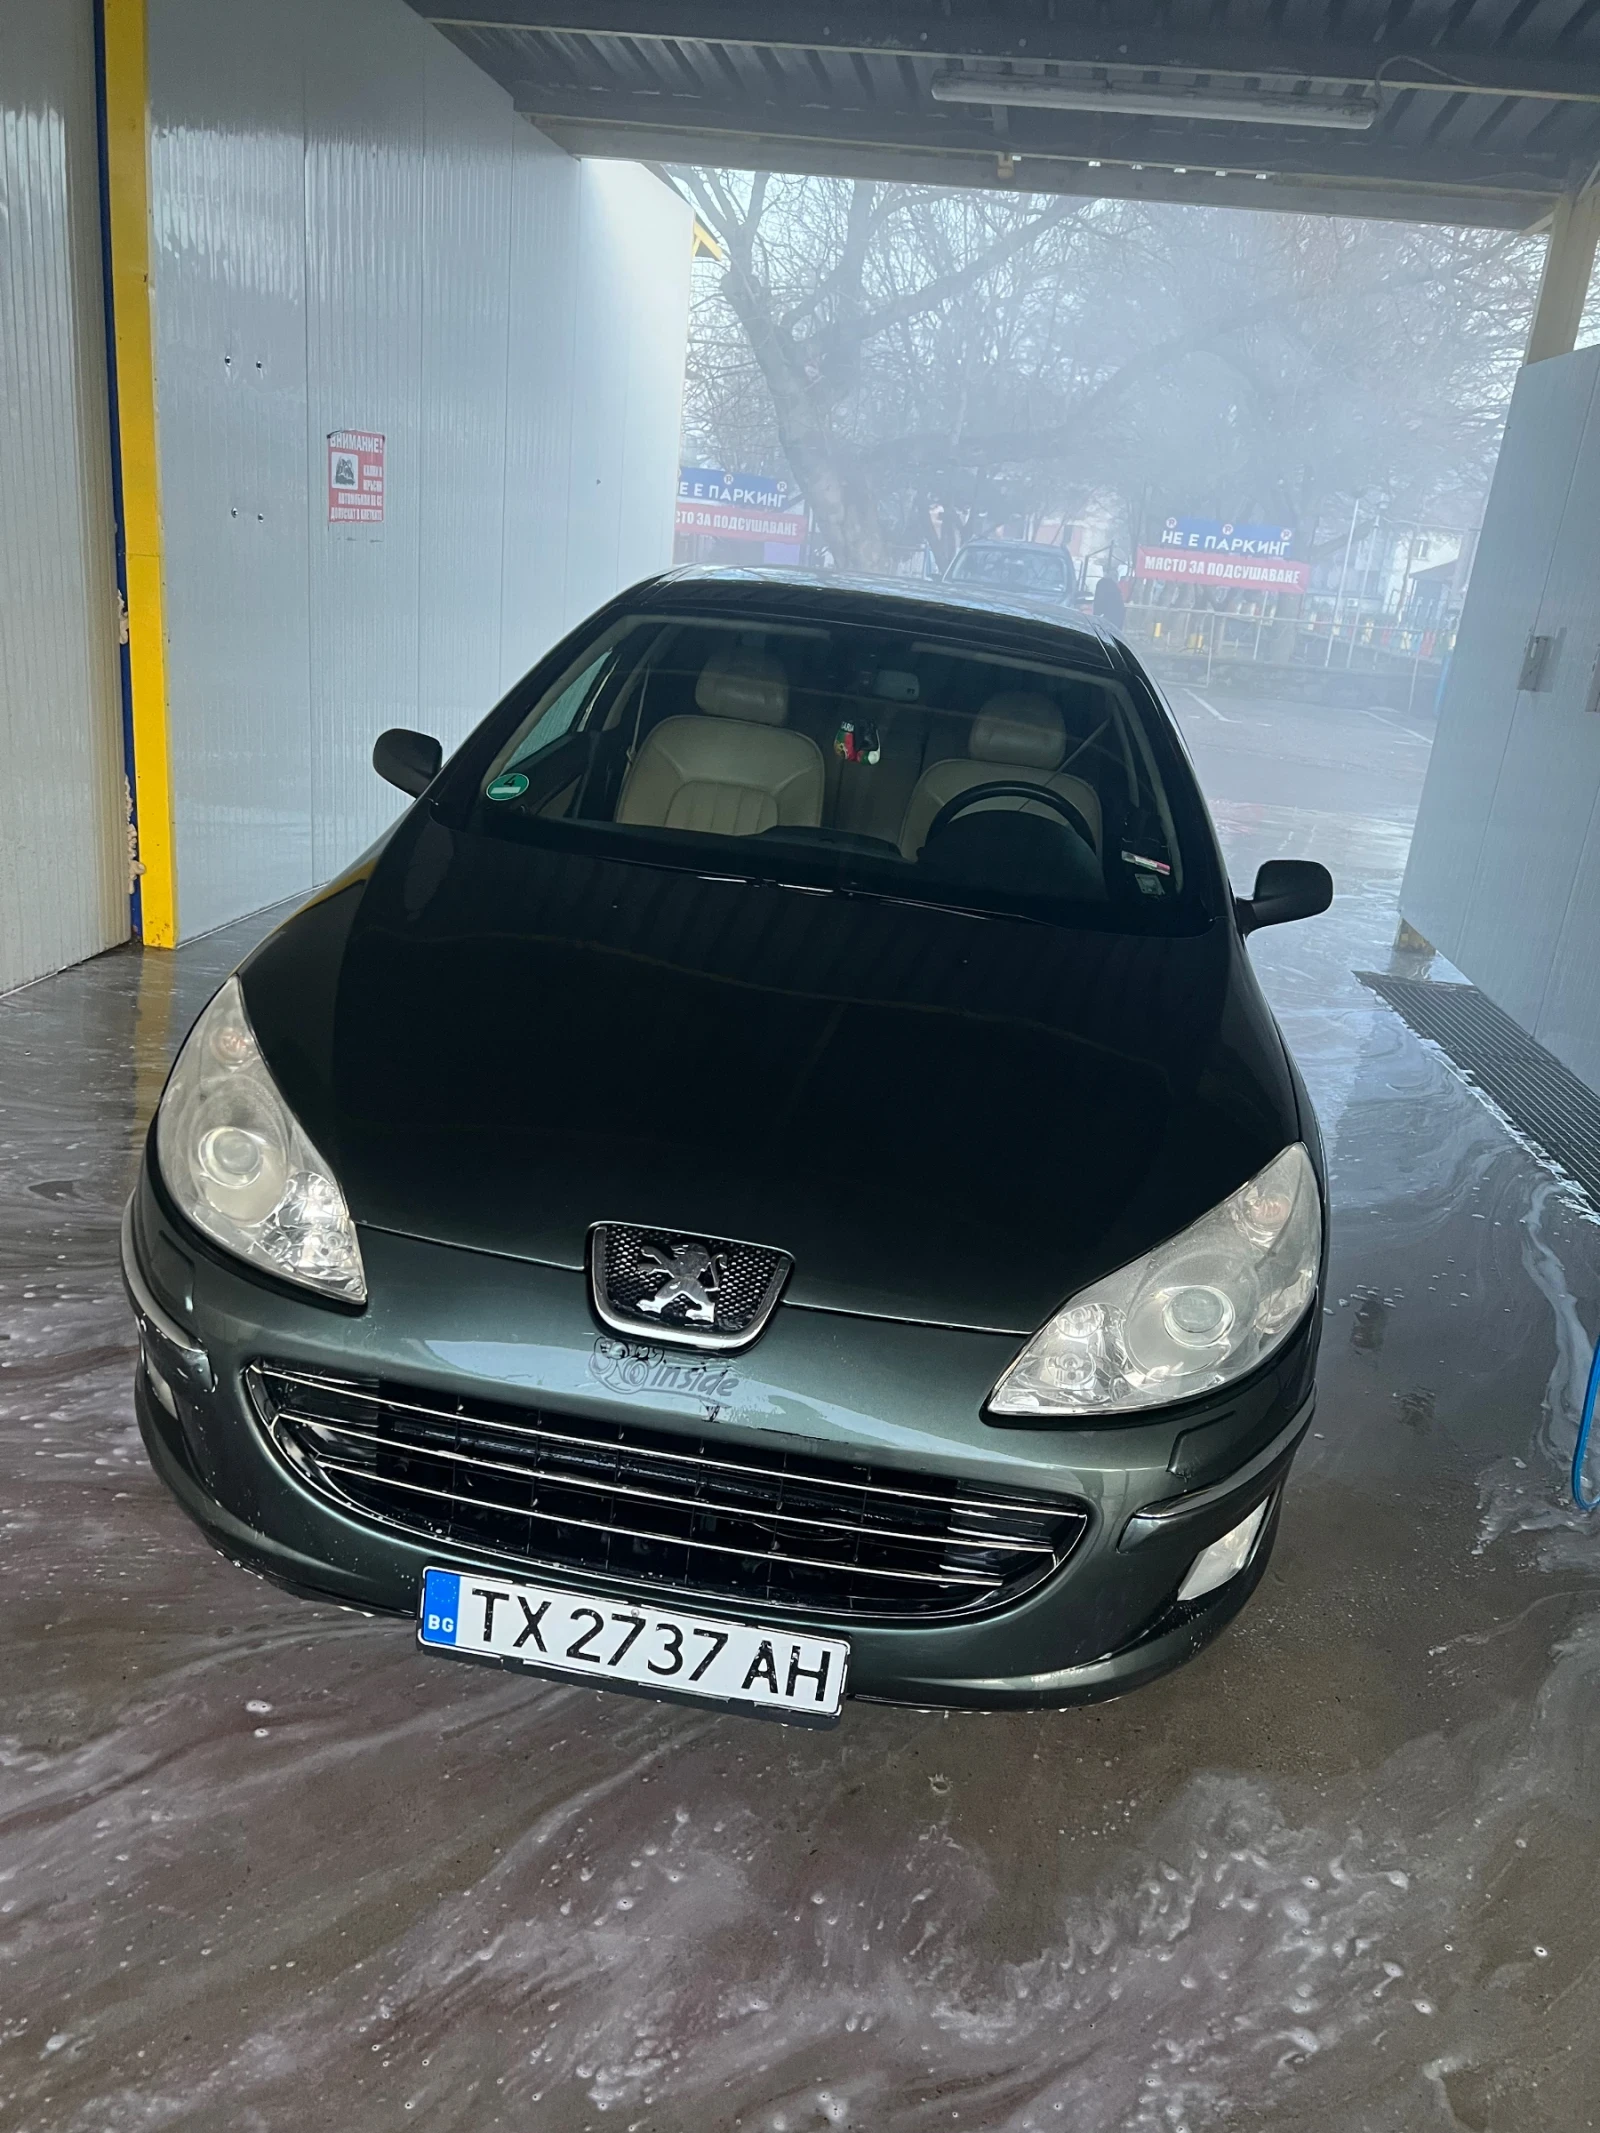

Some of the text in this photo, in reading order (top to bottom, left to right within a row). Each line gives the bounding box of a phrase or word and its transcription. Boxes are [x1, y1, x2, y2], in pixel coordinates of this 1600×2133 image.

[330, 432, 383, 454] ВНИМАНИЕ!
[693, 483, 704, 497] Е
[708, 484, 787, 508] ПАРКИНГ
[696, 512, 712, 527] ЗА
[713, 514, 798, 537] ПОДСУШАВАНЕ
[1161, 530, 1290, 556] НЕ Е ПАРКИНГ
[1144, 555, 1301, 584] МЯСТО ЗА ПОДСУШАВАНЕ
[503, 774, 517, 787] 4
[650, 1359, 740, 1397] inside
[428, 1613, 455, 1634] BG
[472, 1587, 831, 1702] TX 2737 AH
